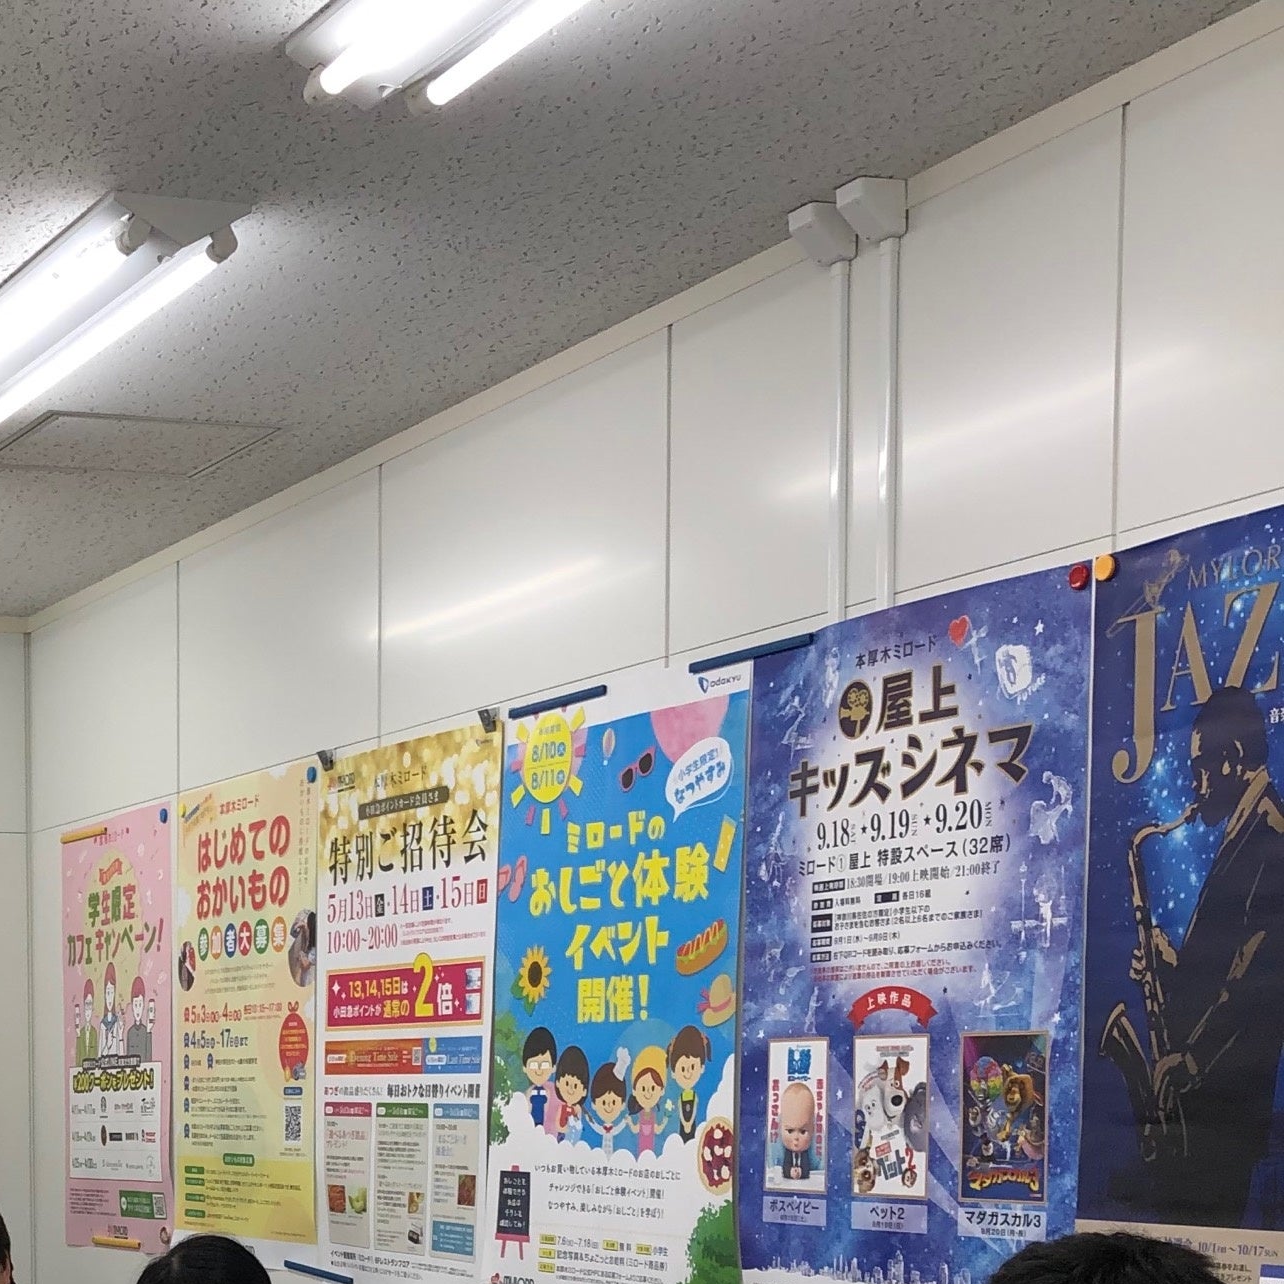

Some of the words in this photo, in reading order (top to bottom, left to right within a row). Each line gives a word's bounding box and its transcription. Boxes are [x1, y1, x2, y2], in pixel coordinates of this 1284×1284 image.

[855, 634, 938, 670] 本厚木ミロード
[875, 663, 959, 734] 屋上
[674, 761, 726, 805] なつやすみ
[788, 720, 1035, 818] キッズシネマ
[197, 815, 291, 875] はじめての
[328, 808, 489, 887] 特別ご招待会
[567, 810, 666, 853] ミロードの
[816, 818, 851, 850] 9.18
[870, 808, 911, 843] 9.19
[935, 798, 983, 834] 9.20
[529, 842, 710, 917] おしごと体験
[848, 850, 871, 871] 屋上
[88, 883, 137, 928] 学生限定
[197, 865, 290, 920] おかいもの
[199, 919, 286, 958] 参加者大募集
[565, 915, 670, 970] イベント
[413, 952, 435, 1018] 2
[437, 982, 454, 1017] 倍
[576, 974, 650, 1024] 開催!
[866, 991, 912, 1012] 上映作品
[869, 1205, 905, 1222] ペット2
[964, 1210, 1041, 1228] マダガスカル3
